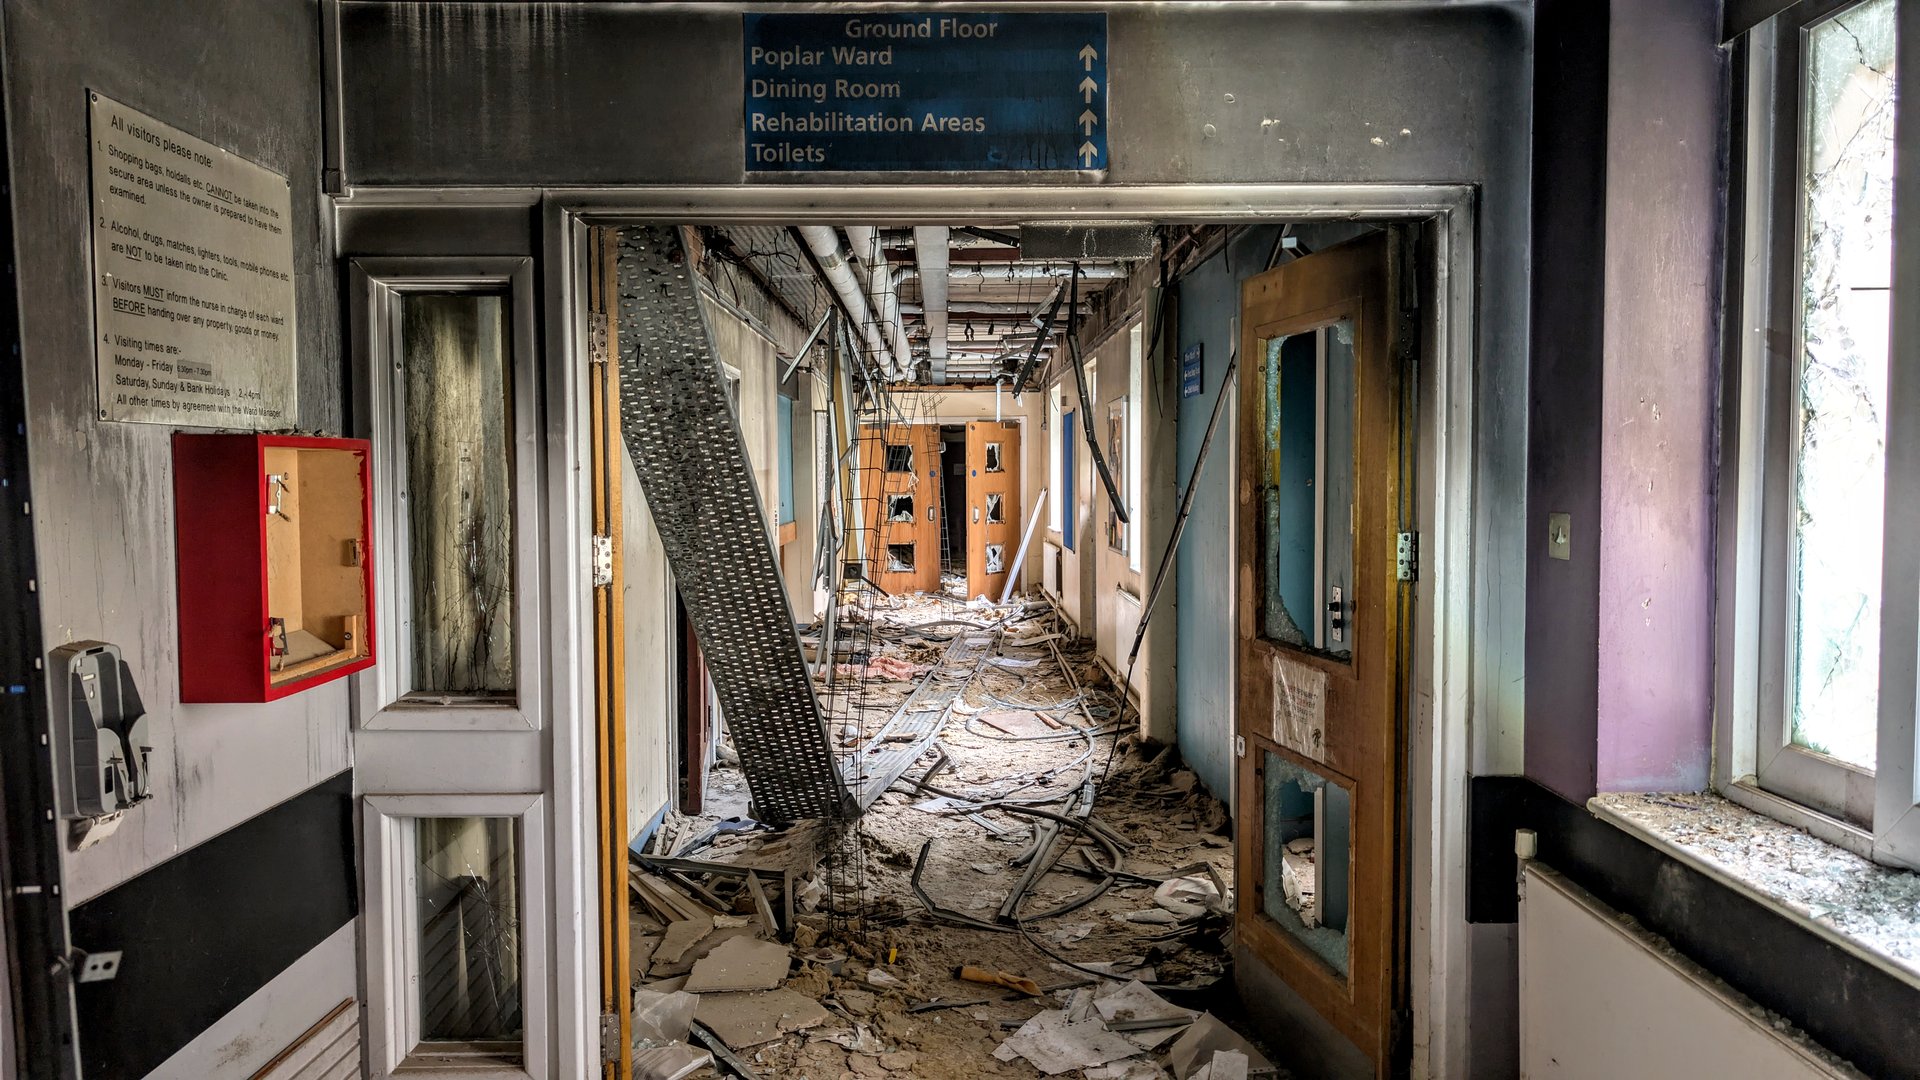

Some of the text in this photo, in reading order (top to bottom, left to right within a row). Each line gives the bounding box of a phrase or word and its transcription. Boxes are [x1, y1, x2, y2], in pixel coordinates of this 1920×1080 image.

[845, 18, 998, 38] Ground Floor
[751, 46, 893, 70] Poplar Ward
[751, 79, 900, 103] Dining Room
[751, 112, 986, 132] Rehabilitation Areas
[111, 115, 213, 169] All visitors please note:
[751, 143, 826, 163] Toilets
[108, 144, 143, 170] Shopping
[145, 158, 164, 176] bags,
[165, 166, 191, 185] holdalls
[193, 179, 204, 191] etc.
[205, 182, 232, 202] CANNOT
[234, 194, 242, 204] be
[243, 198, 258, 212] taken
[259, 205, 269, 215] into
[270, 208, 279, 219] the
[108, 166, 282, 235] secure area unless the owner is prepared to have them
[109, 185, 147, 205] examined.
[99, 217, 106, 229] 2.
[111, 220, 141, 241] Alcohol,
[142, 230, 165, 247] drugs,
[166, 239, 196, 256] matches,
[197, 247, 222, 263] lighters,
[223, 254, 239, 268] tools,
[240, 261, 259, 273] mobile
[259, 266, 279, 279] phones
[111, 242, 228, 282] are NOT to be taken into the Clinic.
[101, 275, 284, 326] 3. Visitors MUST inform the nurse in charge of each ward
[113, 297, 146, 316] BEFORE
[147, 304, 175, 322] handing
[176, 312, 191, 322] over
[193, 316, 204, 328] any
[234, 324, 252, 335] goods
[253, 328, 260, 336] or
[103, 333, 110, 344] 4.
[114, 334, 143, 352] Visiting
[144, 340, 164, 352] times
[114, 354, 144, 371] Monday
[151, 359, 174, 375] Friday
[152, 378, 178, 394] Sunday
[180, 381, 185, 392] &
[186, 382, 203, 394] Bank
[204, 384, 231, 398] Holidays
[248, 390, 261, 400] 4pm
[116, 393, 127, 405] All
[129, 396, 149, 407] other
[151, 397, 171, 409] times
[172, 399, 180, 412] by
[182, 402, 216, 413] agreement
[217, 403, 231, 413] with
[243, 406, 257, 416] Ward
